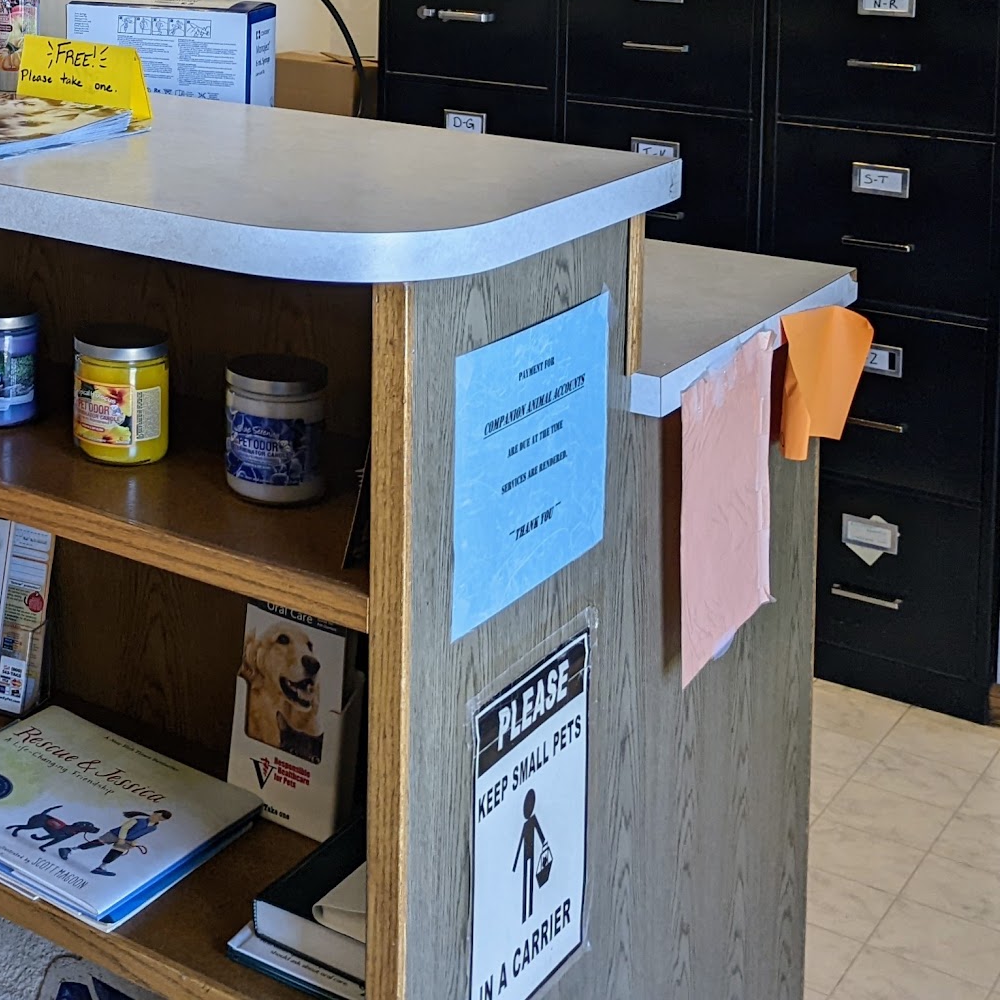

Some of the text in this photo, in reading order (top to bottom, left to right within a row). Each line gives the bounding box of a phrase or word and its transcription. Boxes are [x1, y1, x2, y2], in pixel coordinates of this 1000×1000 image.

[874, 0, 898, 9] N-R
[55, 41, 97, 69] FREE!
[21, 69, 118, 93] Please take one.
[453, 116, 475, 130] D-G
[864, 174, 888, 184] S-T
[518, 356, 555, 381] PAYMENT FOR
[89, 403, 110, 415] ODOR
[484, 373, 586, 436] COMPANION ANIMAL ACCOUNTS
[253, 440, 279, 451] ODOR
[507, 420, 563, 458] ARE DUE AT THE TIME
[501, 449, 568, 495] SERVICES ARE RENDERED.
[266, 601, 313, 624] Oral Care
[497, 659, 570, 751] PLEASE
[12, 741, 68, 773] Life-Changing
[71, 770, 115, 796] Friendship
[13, 725, 169, 804] Rescue & Jessica
[273, 757, 311, 778] Responsible
[277, 766, 310, 786] Healthcare
[478, 714, 582, 823] KEEP SMALL PETS
[273, 772, 296, 789] for Pets
[263, 803, 290, 820] Take one
[31, 856, 56, 876] SCOTT
[55, 867, 89, 890] MAGOON
[479, 898, 571, 1000] IN A CARRIER
